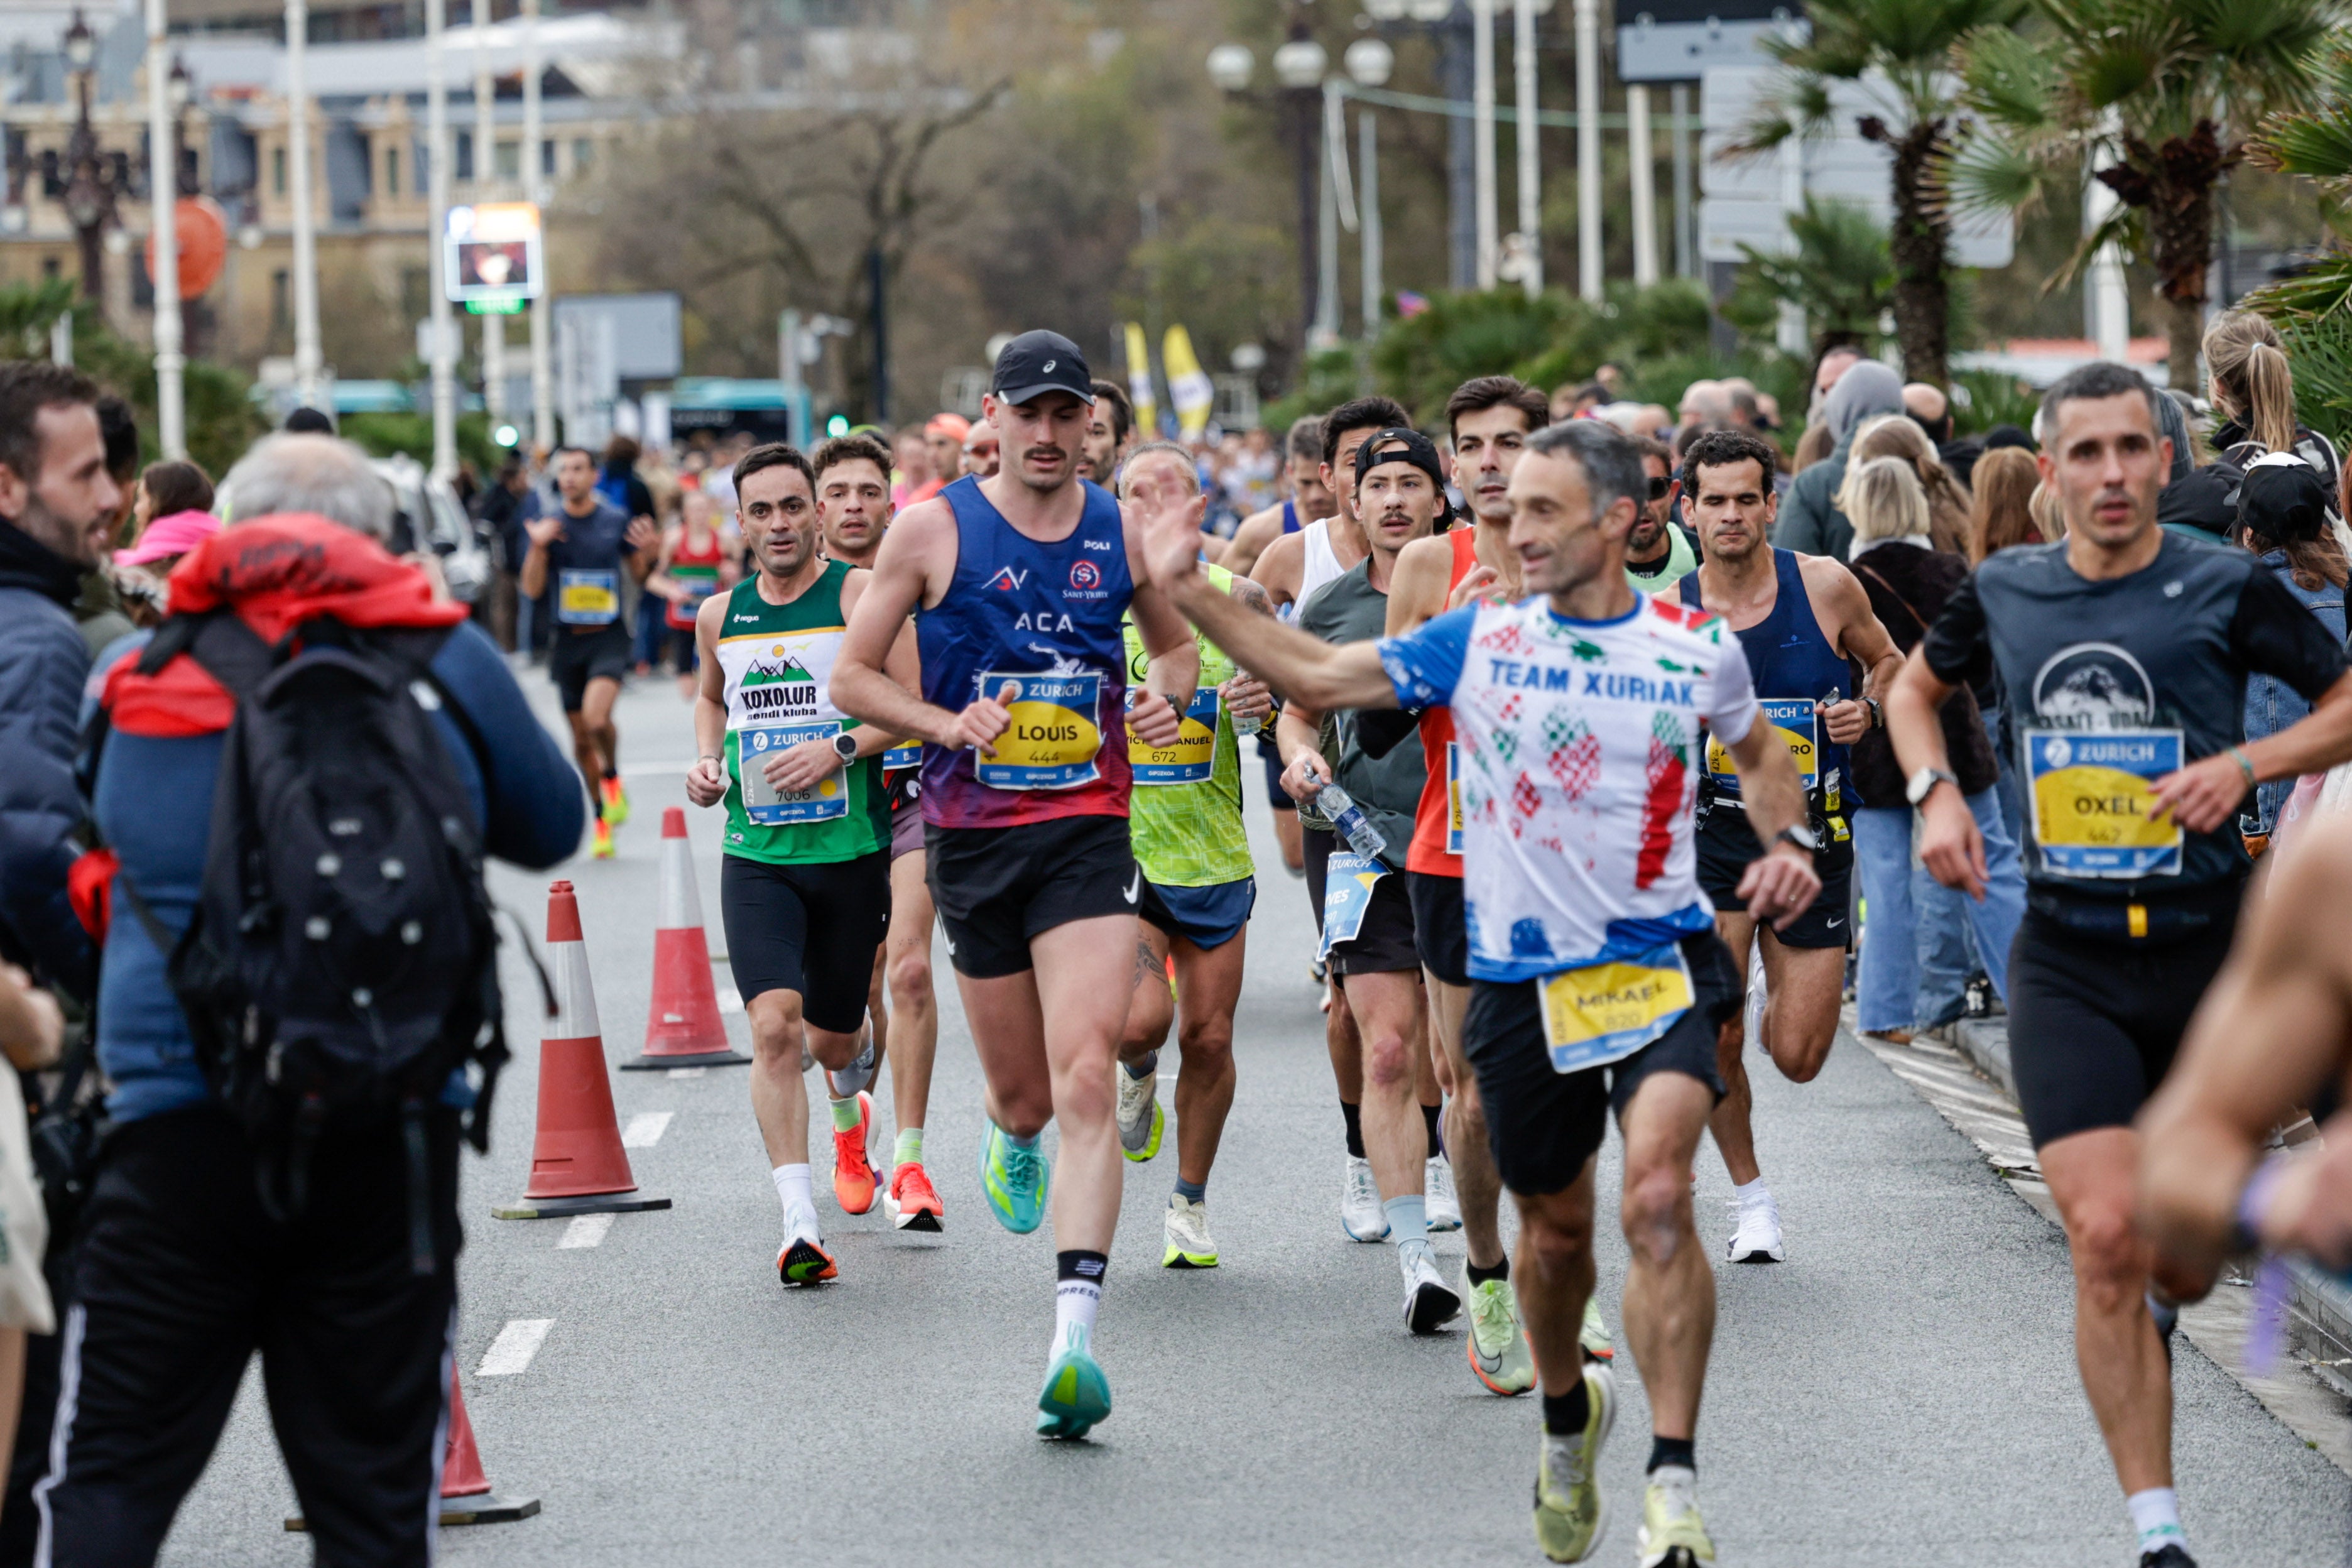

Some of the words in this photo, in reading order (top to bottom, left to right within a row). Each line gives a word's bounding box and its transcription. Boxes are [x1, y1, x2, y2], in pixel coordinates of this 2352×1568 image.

[1084, 540, 1111, 550] POLI
[1015, 612, 1074, 633] ACA
[1489, 658, 1569, 692] TEAM
[1584, 672, 1694, 707] XURIAK
[1029, 684, 1083, 697] ZURICH
[783, 707, 817, 717] kluba
[1763, 707, 1797, 719] RICH
[773, 731, 823, 746] ZURICH
[1018, 725, 1078, 741] LOUIS
[1029, 751, 1060, 764] 444
[1152, 751, 1177, 762] 672
[2078, 743, 2155, 761] ZURICH
[776, 788, 811, 802] 7006
[2075, 796, 2142, 815] OXEL
[1331, 858, 1372, 871] ZURICH
[1577, 979, 1669, 1008] MIKAEL
